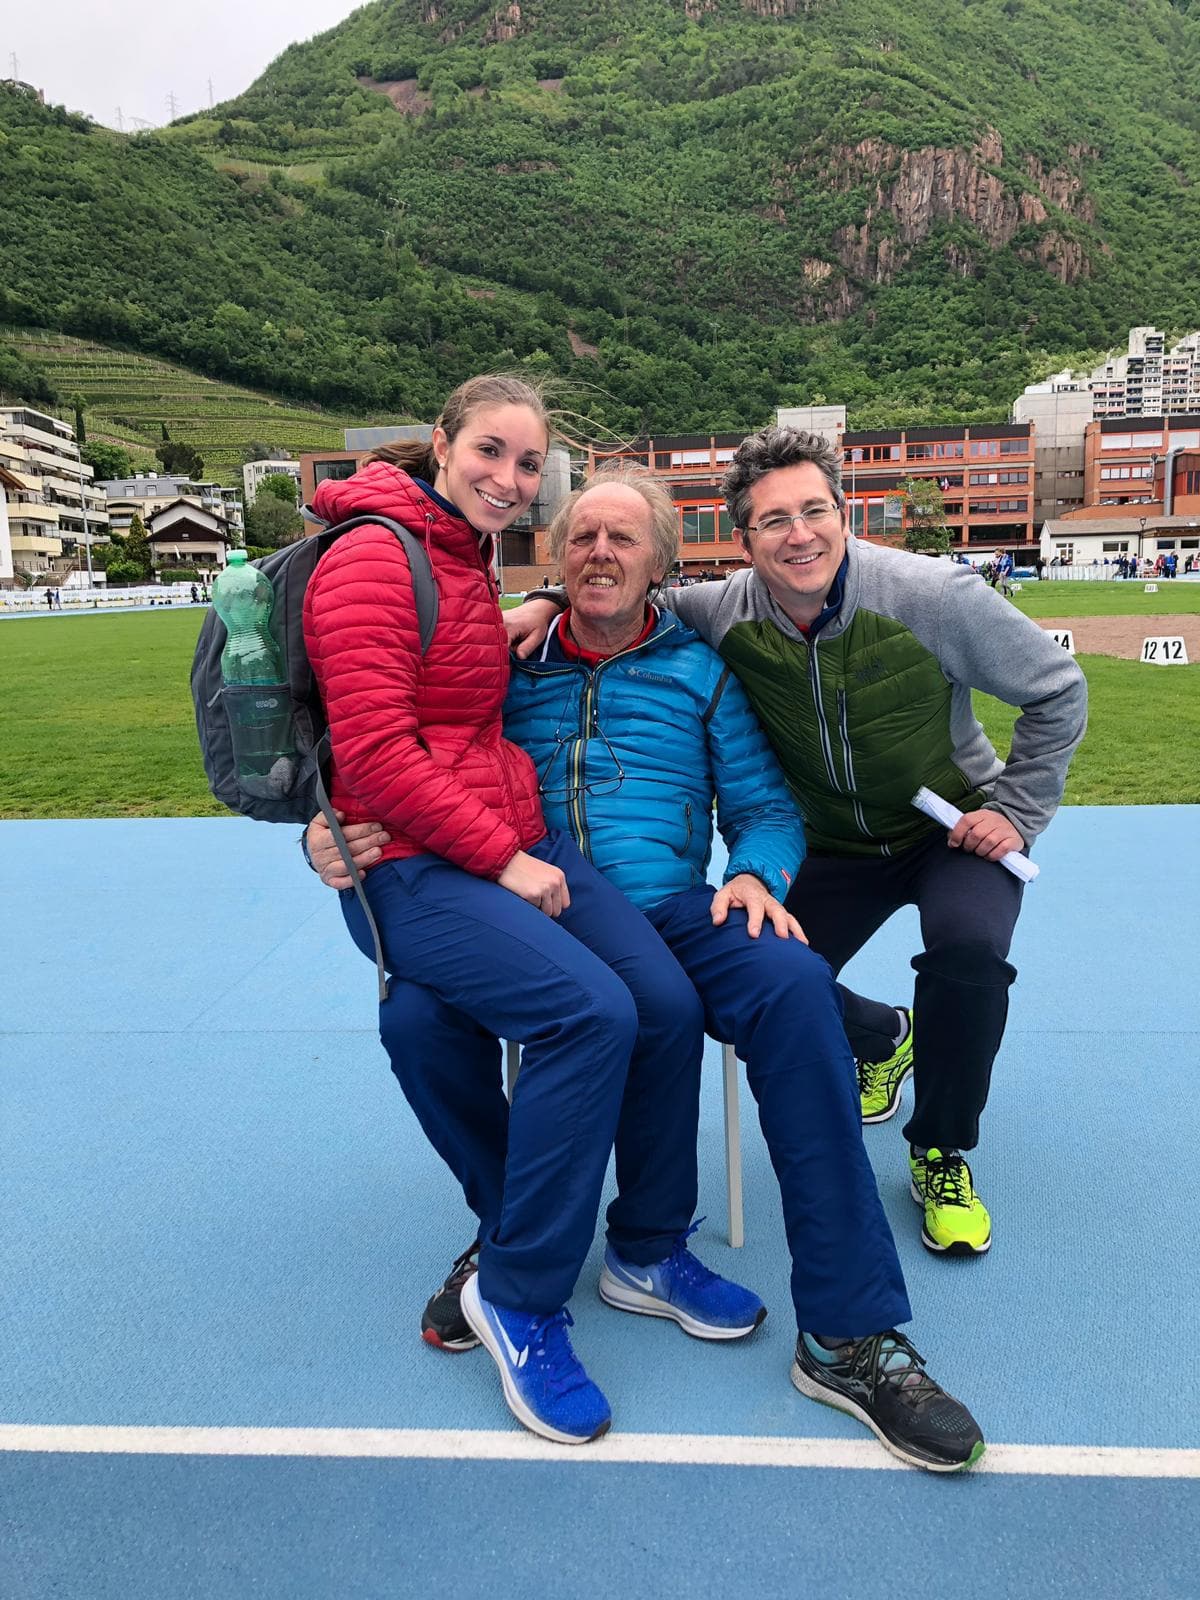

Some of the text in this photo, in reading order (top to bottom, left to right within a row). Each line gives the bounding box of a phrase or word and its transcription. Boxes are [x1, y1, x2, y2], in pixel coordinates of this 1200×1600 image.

[1144, 640, 1183, 660] 12 12
[636, 669, 673, 684] Columbia
